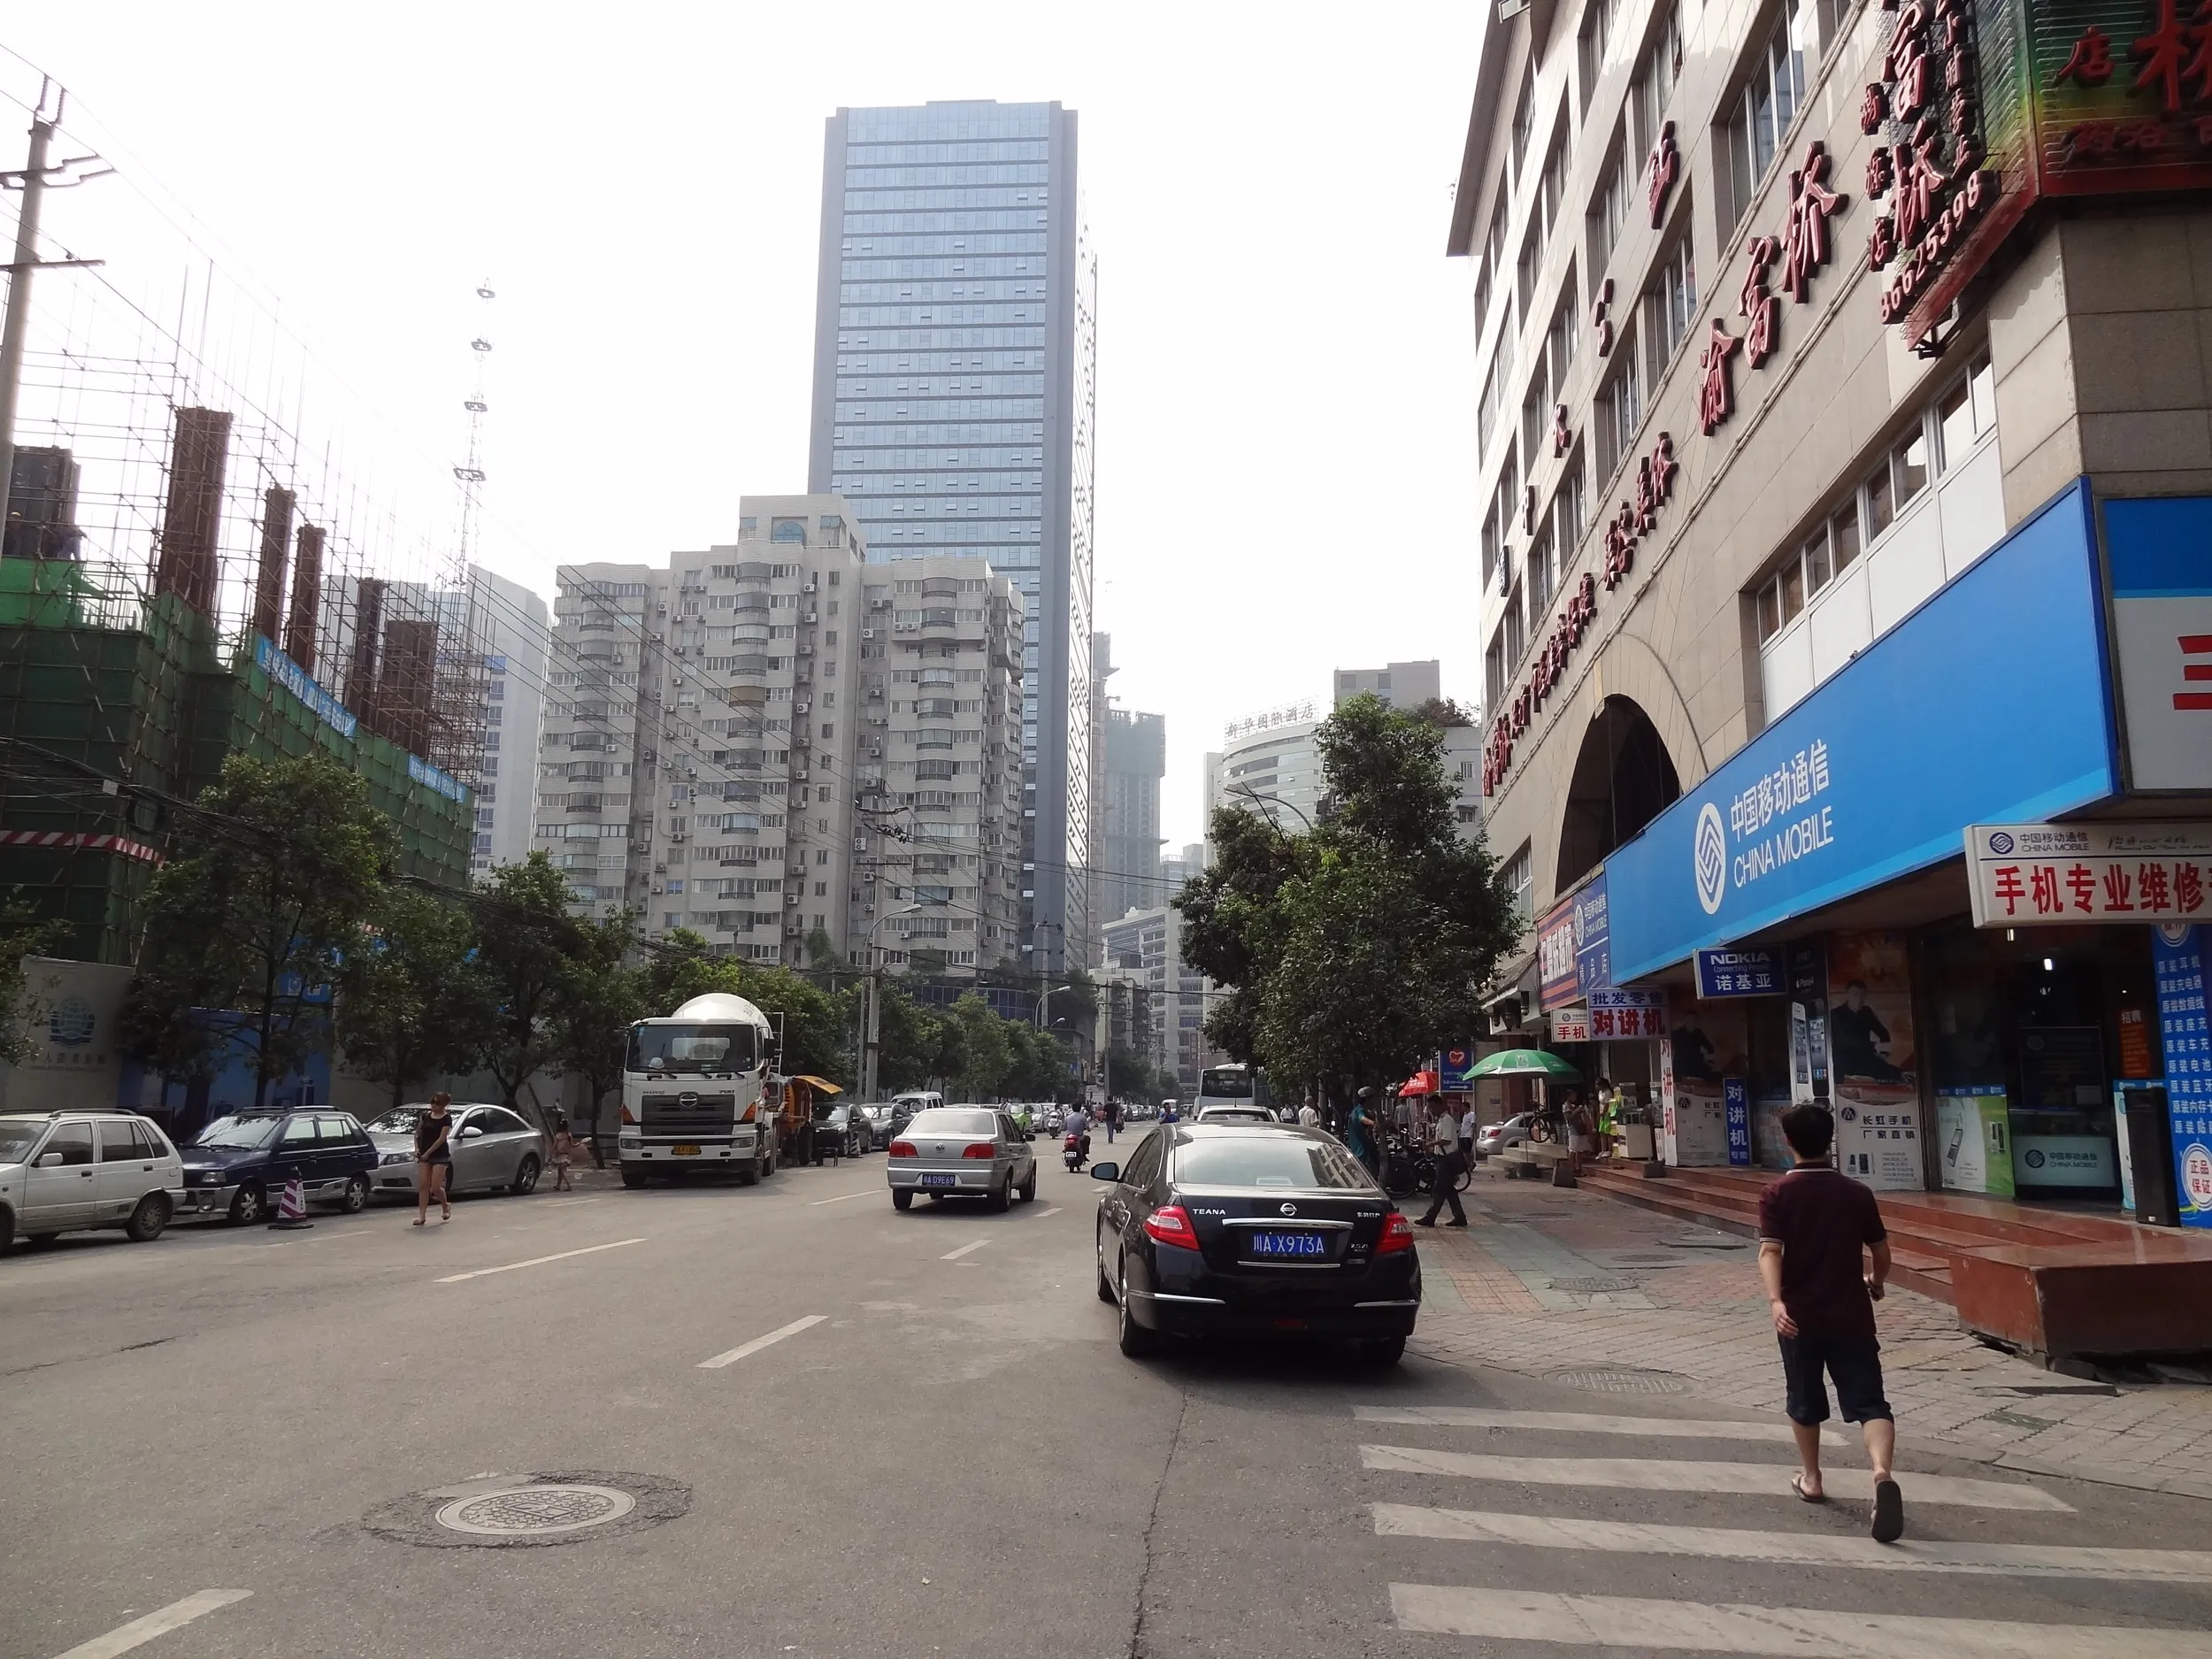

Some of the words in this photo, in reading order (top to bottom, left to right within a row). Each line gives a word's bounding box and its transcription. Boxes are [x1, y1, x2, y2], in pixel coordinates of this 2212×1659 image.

[1879, 170, 1987, 325] 86625398
[1731, 739, 1829, 842] 中国移动通信
[2019, 833, 2088, 843] 中国移动通信
[1733, 841, 1775, 888] CHINA
[1777, 805, 1834, 866] MOBILE
[2022, 843, 2053, 853] CHINA
[2055, 842, 2090, 852] MOBILE
[1995, 862, 2212, 916] 手机专业维修
[1710, 952, 1771, 964] NOKIA
[1714, 964, 1747, 973] Connecting
[1715, 973, 1772, 991] 诺基亚
[2160, 975, 2202, 994] 原装充电器
[1593, 992, 1663, 1004] 批发零售
[2162, 996, 2205, 1013] 原装数据线
[1594, 1009, 1666, 1036] 对讲机
[2164, 1017, 2208, 1033] 原装座充
[1557, 1026, 1587, 1040] 手机
[2166, 1037, 2209, 1053] 原装车充
[2168, 1058, 2212, 1074] 原装电池
[1727, 1086, 1748, 1147] 对讲机
[1863, 1115, 1911, 1125] 长虹手机
[1863, 1130, 1915, 1139] 厂家直销
[2190, 1160, 2210, 1174] 正品
[2192, 1179, 2212, 1194] 保证
